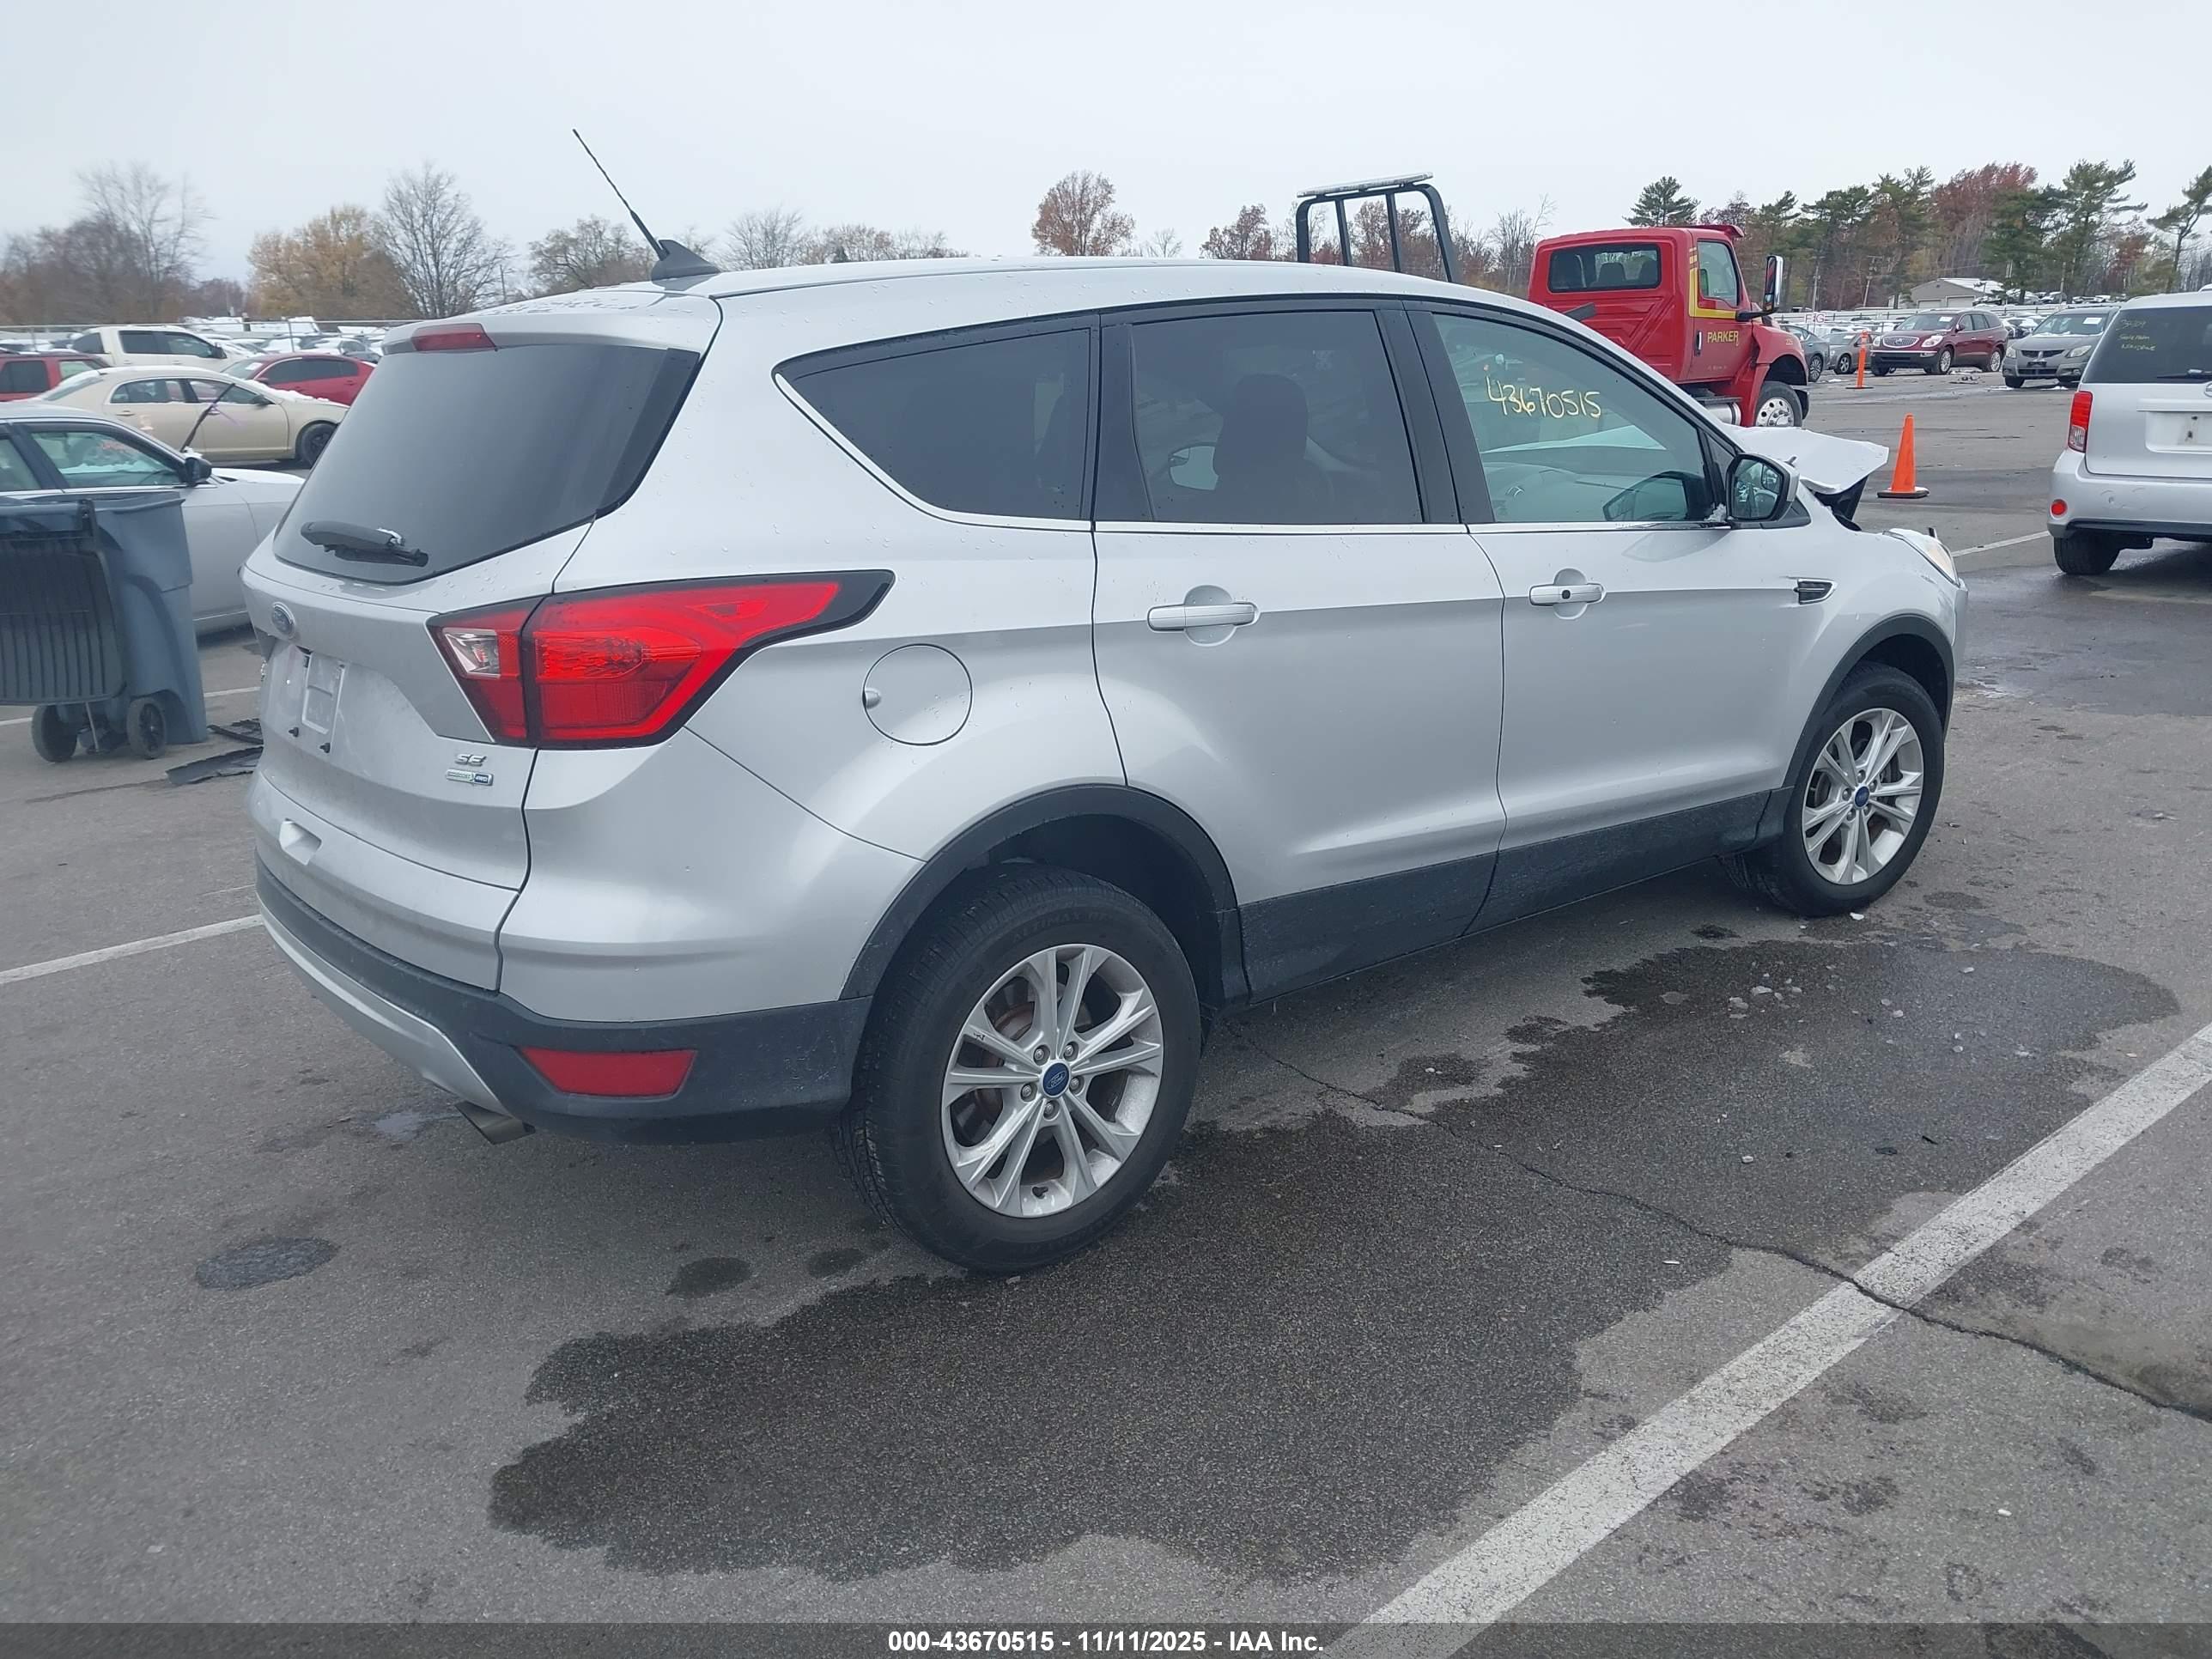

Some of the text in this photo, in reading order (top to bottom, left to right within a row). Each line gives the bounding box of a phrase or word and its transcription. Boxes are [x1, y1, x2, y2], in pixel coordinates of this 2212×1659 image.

[1707, 330, 1739, 346] PARKER
[1486, 375, 1601, 418] 43670515
[455, 753, 487, 766] SE
